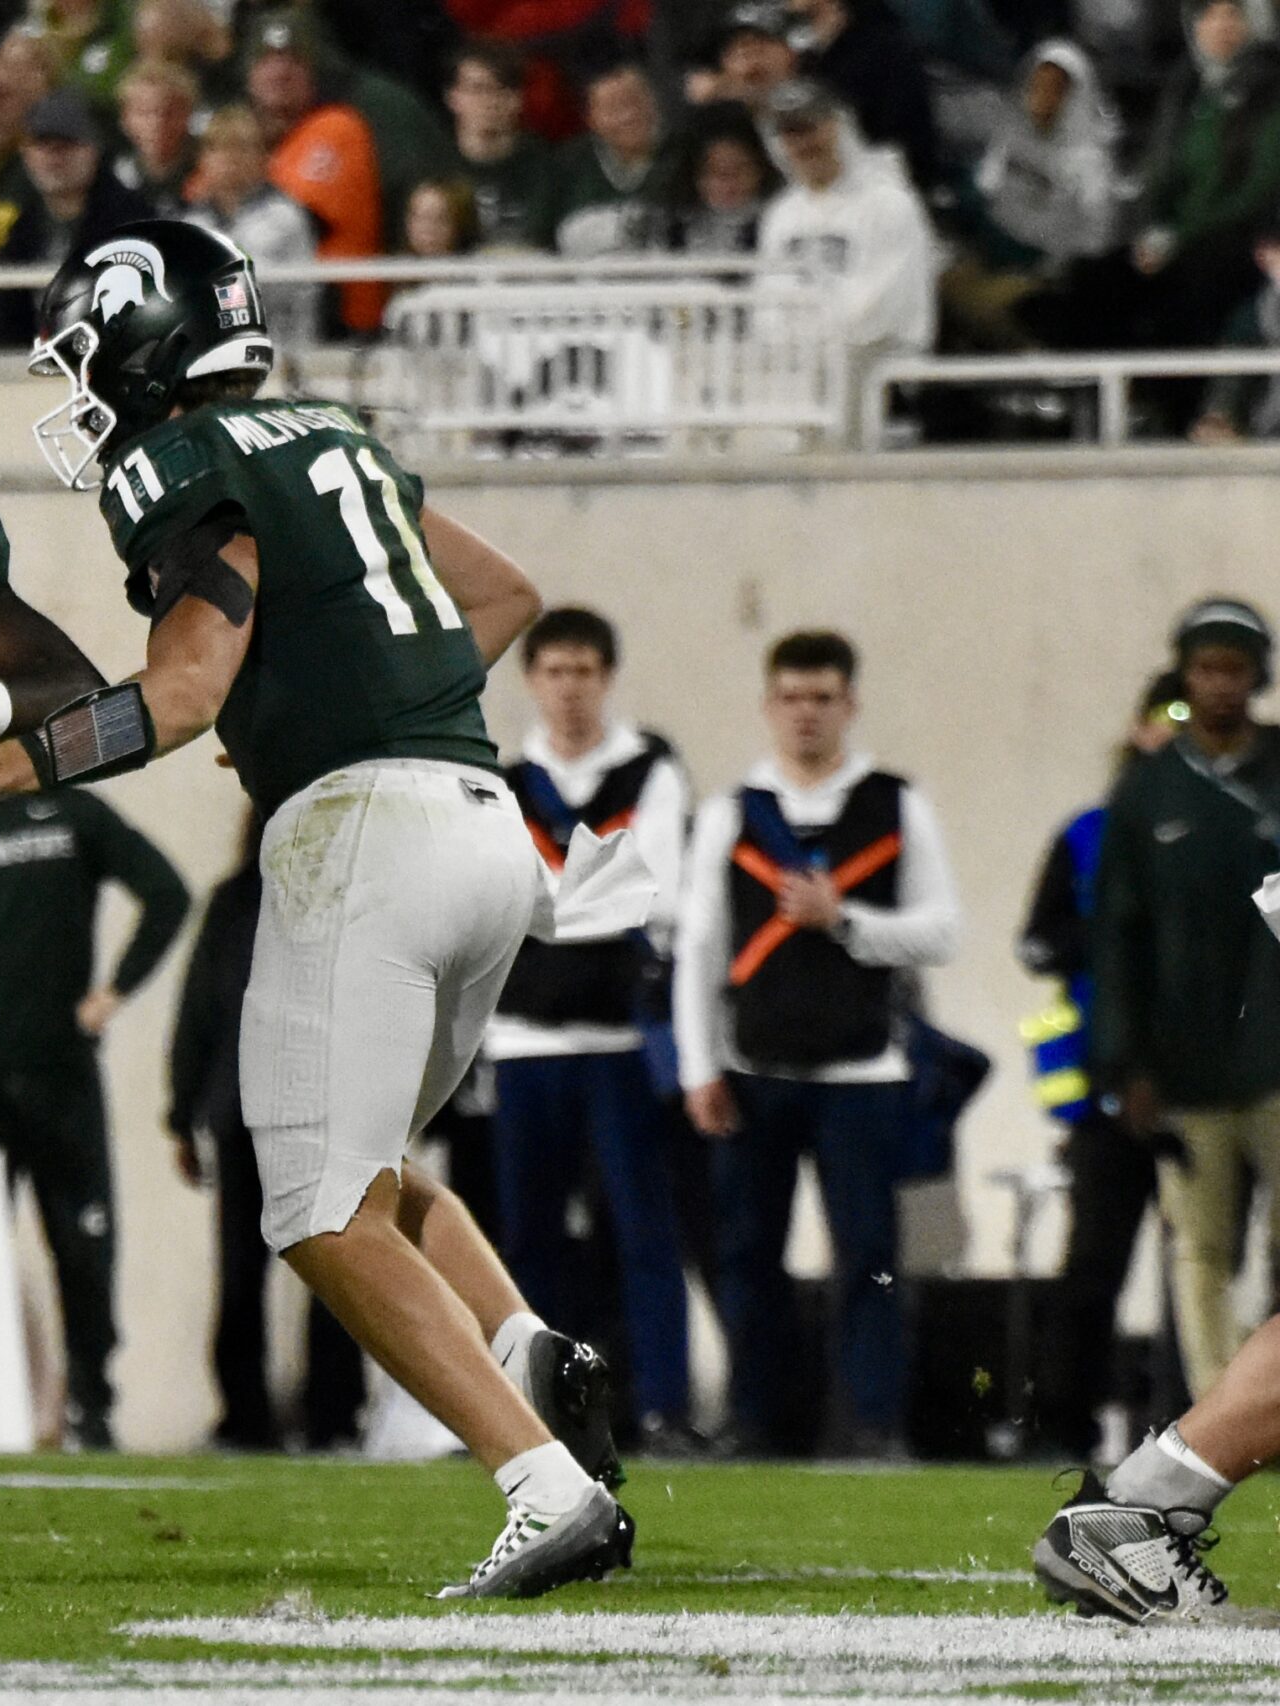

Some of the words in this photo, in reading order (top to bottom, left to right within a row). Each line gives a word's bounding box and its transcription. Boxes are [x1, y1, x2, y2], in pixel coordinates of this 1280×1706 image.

[107, 448, 165, 524] 11
[307, 448, 463, 636] 11
[1068, 1550, 1123, 1597] FORCE
